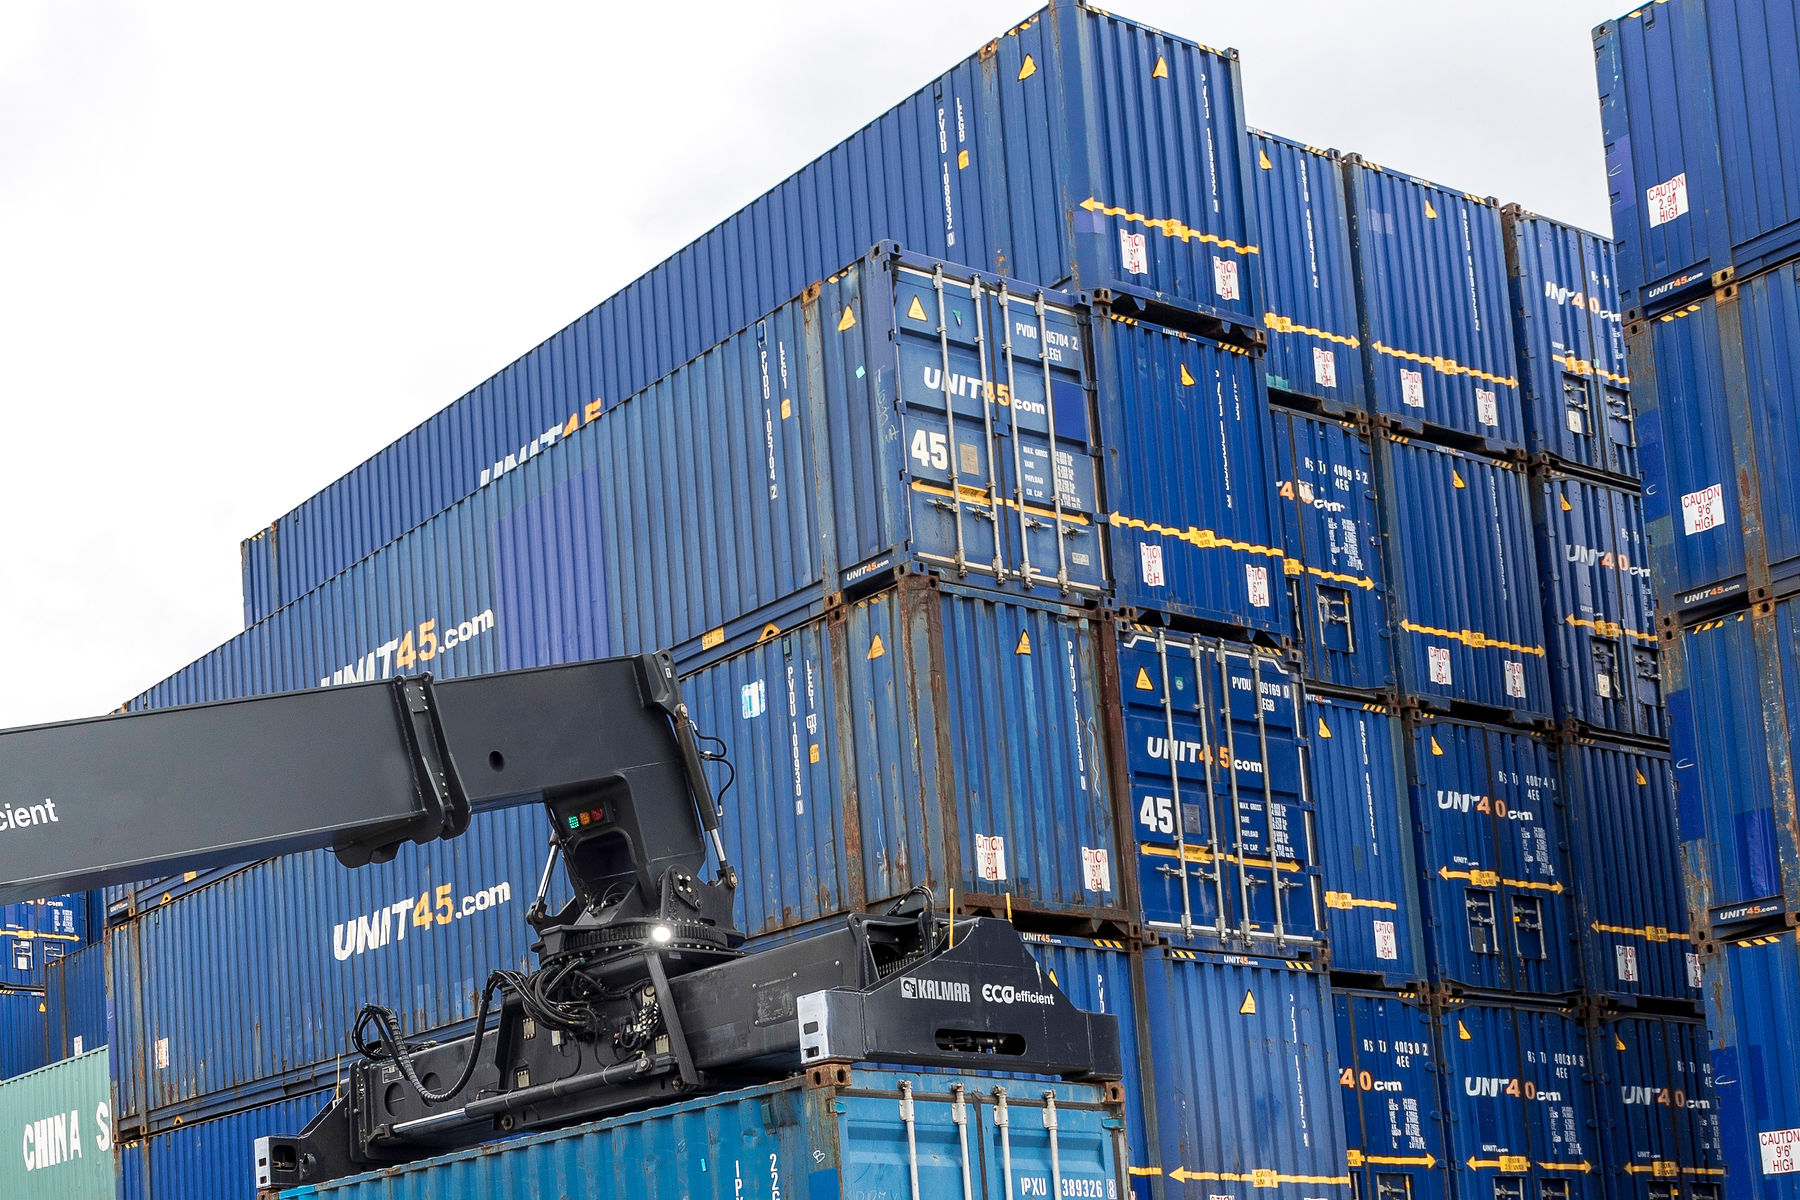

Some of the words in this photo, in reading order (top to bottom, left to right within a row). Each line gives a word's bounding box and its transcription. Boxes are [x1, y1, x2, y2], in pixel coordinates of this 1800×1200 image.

[1648, 272, 1703, 298] UNIT45.com
[1016, 322, 1037, 340] PVDU
[1046, 331, 1069, 348] 05704
[923, 366, 1046, 415] UNIT45com
[911, 429, 948, 471] 45
[846, 559, 889, 581] UNIT45.com
[1684, 583, 1740, 604] UNIT45.com
[1232, 676, 1251, 691] PVDU
[1260, 681, 1281, 697] 09169
[1147, 736, 1263, 773] UNIT45com
[1139, 796, 1174, 834] 45
[333, 879, 511, 961] UNIT45.com
[1719, 904, 1778, 921] UNIT45.com
[1022, 932, 1062, 945] UNIT45.com
[917, 978, 970, 1003] KALMAR
[22, 1109, 82, 1171] CHINA
[1020, 1177, 1047, 1196] IPXU
[1062, 1178, 1102, 1198] 389326
[1107, 1178, 1117, 1199] 8
